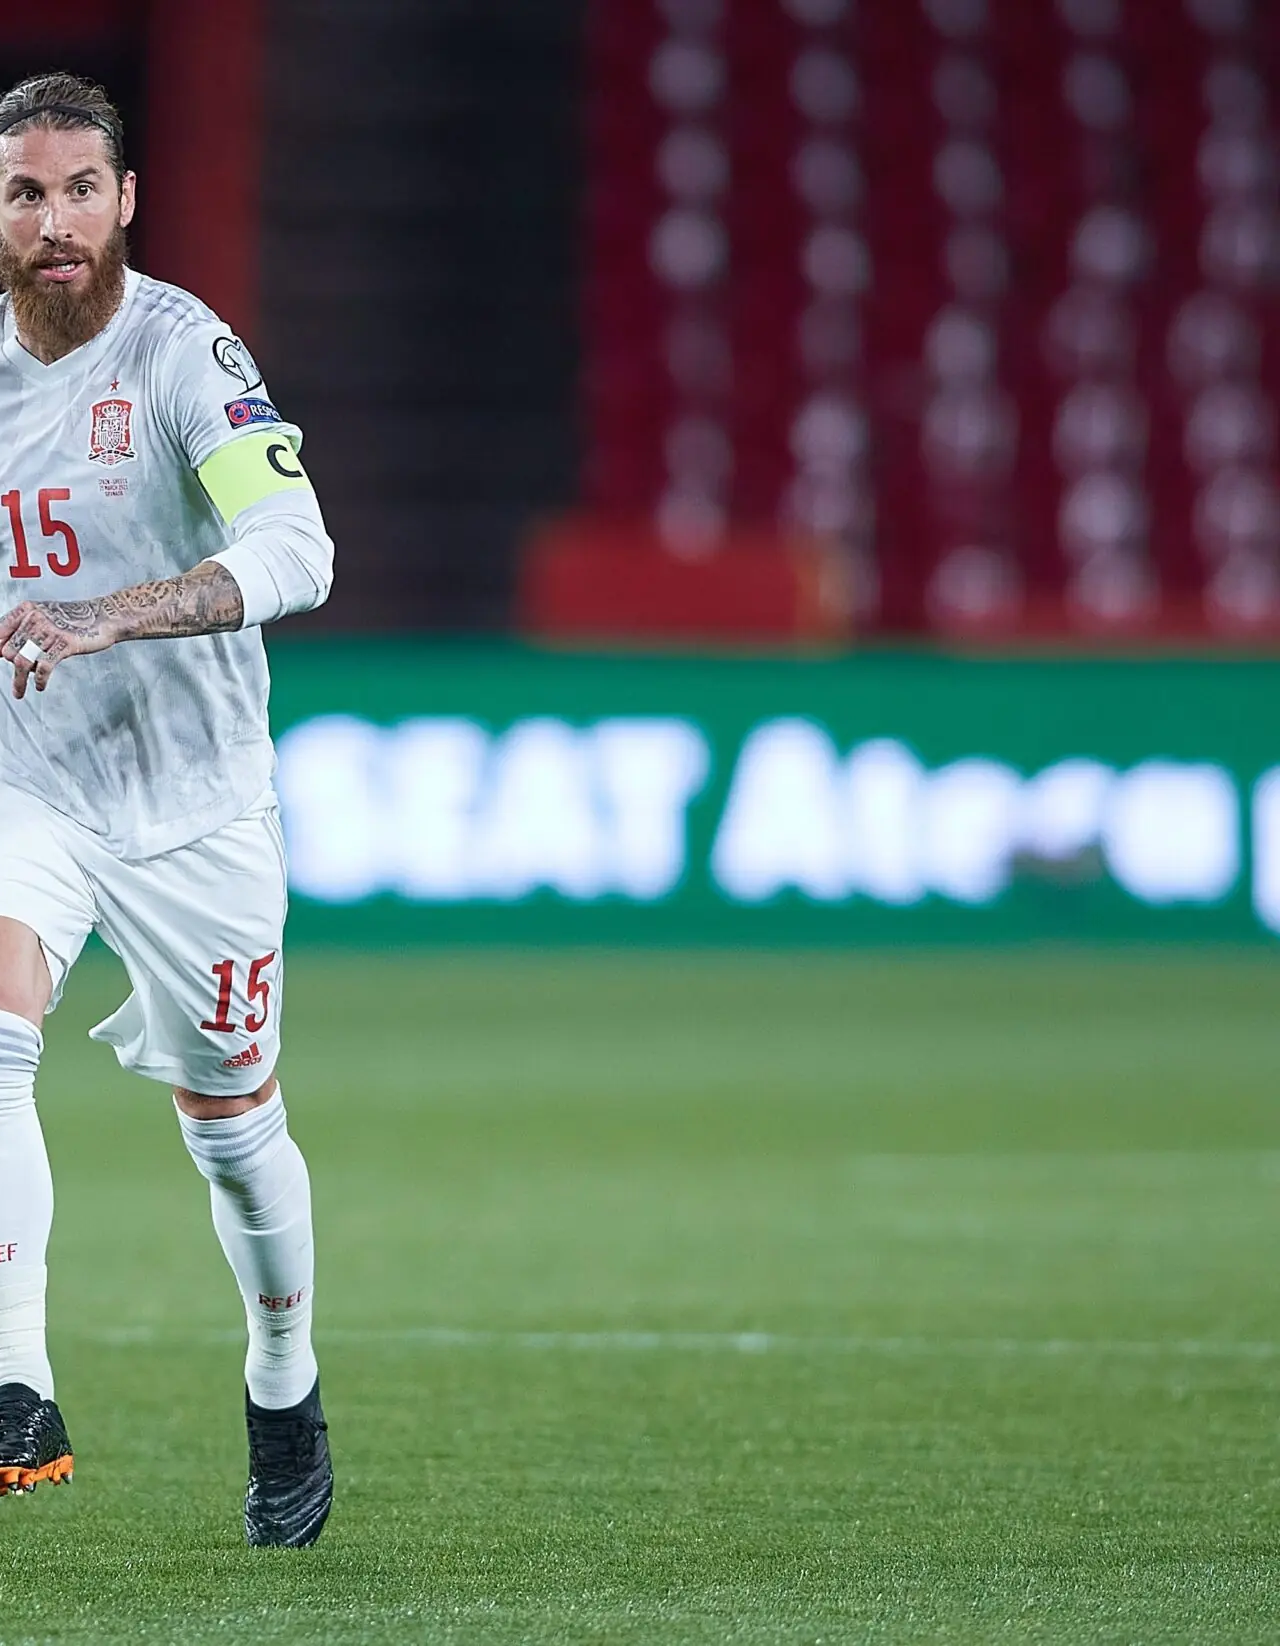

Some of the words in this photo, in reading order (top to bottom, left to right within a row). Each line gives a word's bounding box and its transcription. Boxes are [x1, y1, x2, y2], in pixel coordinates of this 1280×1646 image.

[266, 443, 303, 478] C
[0, 487, 81, 578] 15
[277, 714, 710, 902] SEAT
[200, 950, 276, 1033] 15
[258, 1286, 305, 1311] RFEF
